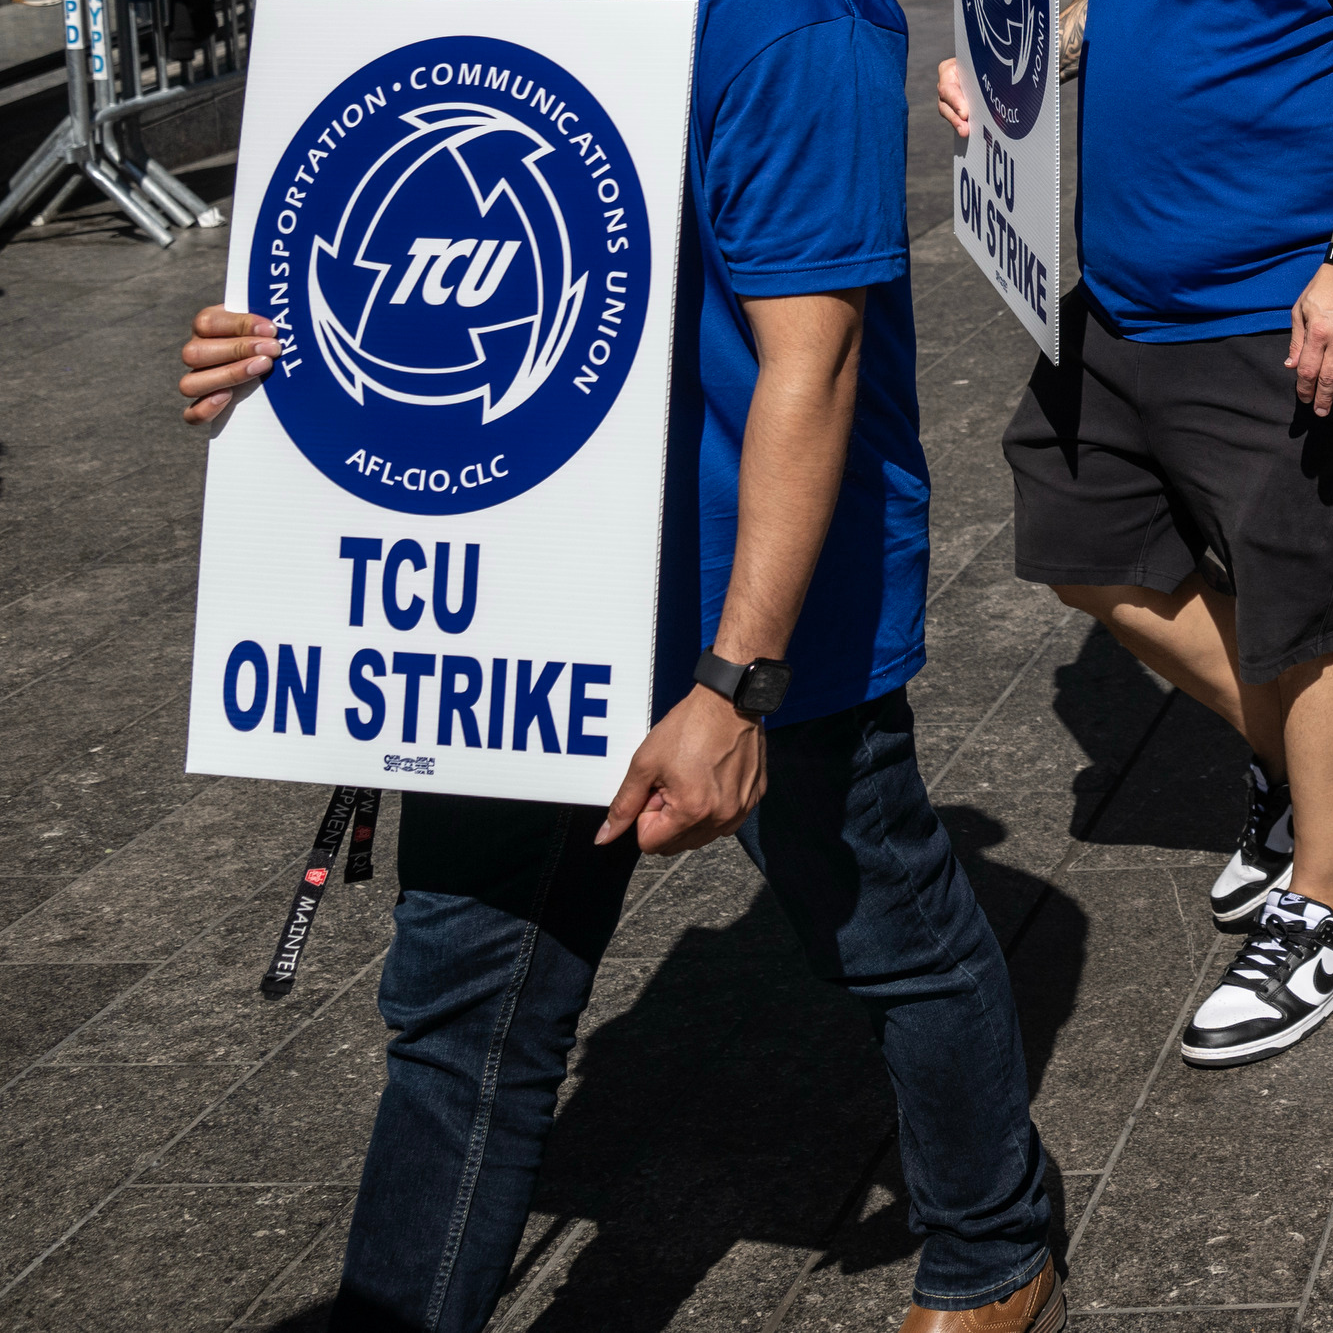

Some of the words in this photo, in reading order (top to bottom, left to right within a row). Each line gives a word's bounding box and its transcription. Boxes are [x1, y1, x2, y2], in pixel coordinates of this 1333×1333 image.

[1032, 11, 1045, 89] UNION
[983, 125, 1014, 213] TCU
[269, 86, 389, 378] TRANSPORTATION
[409, 62, 629, 255] COMMUNICATIONS
[572, 270, 629, 395] UNION
[389, 237, 522, 307] TCU
[960, 167, 981, 241] ON
[986, 199, 1047, 325] STRIKE
[339, 536, 481, 634] TCU
[223, 639, 322, 736] ON
[344, 647, 612, 757] STRIKE
